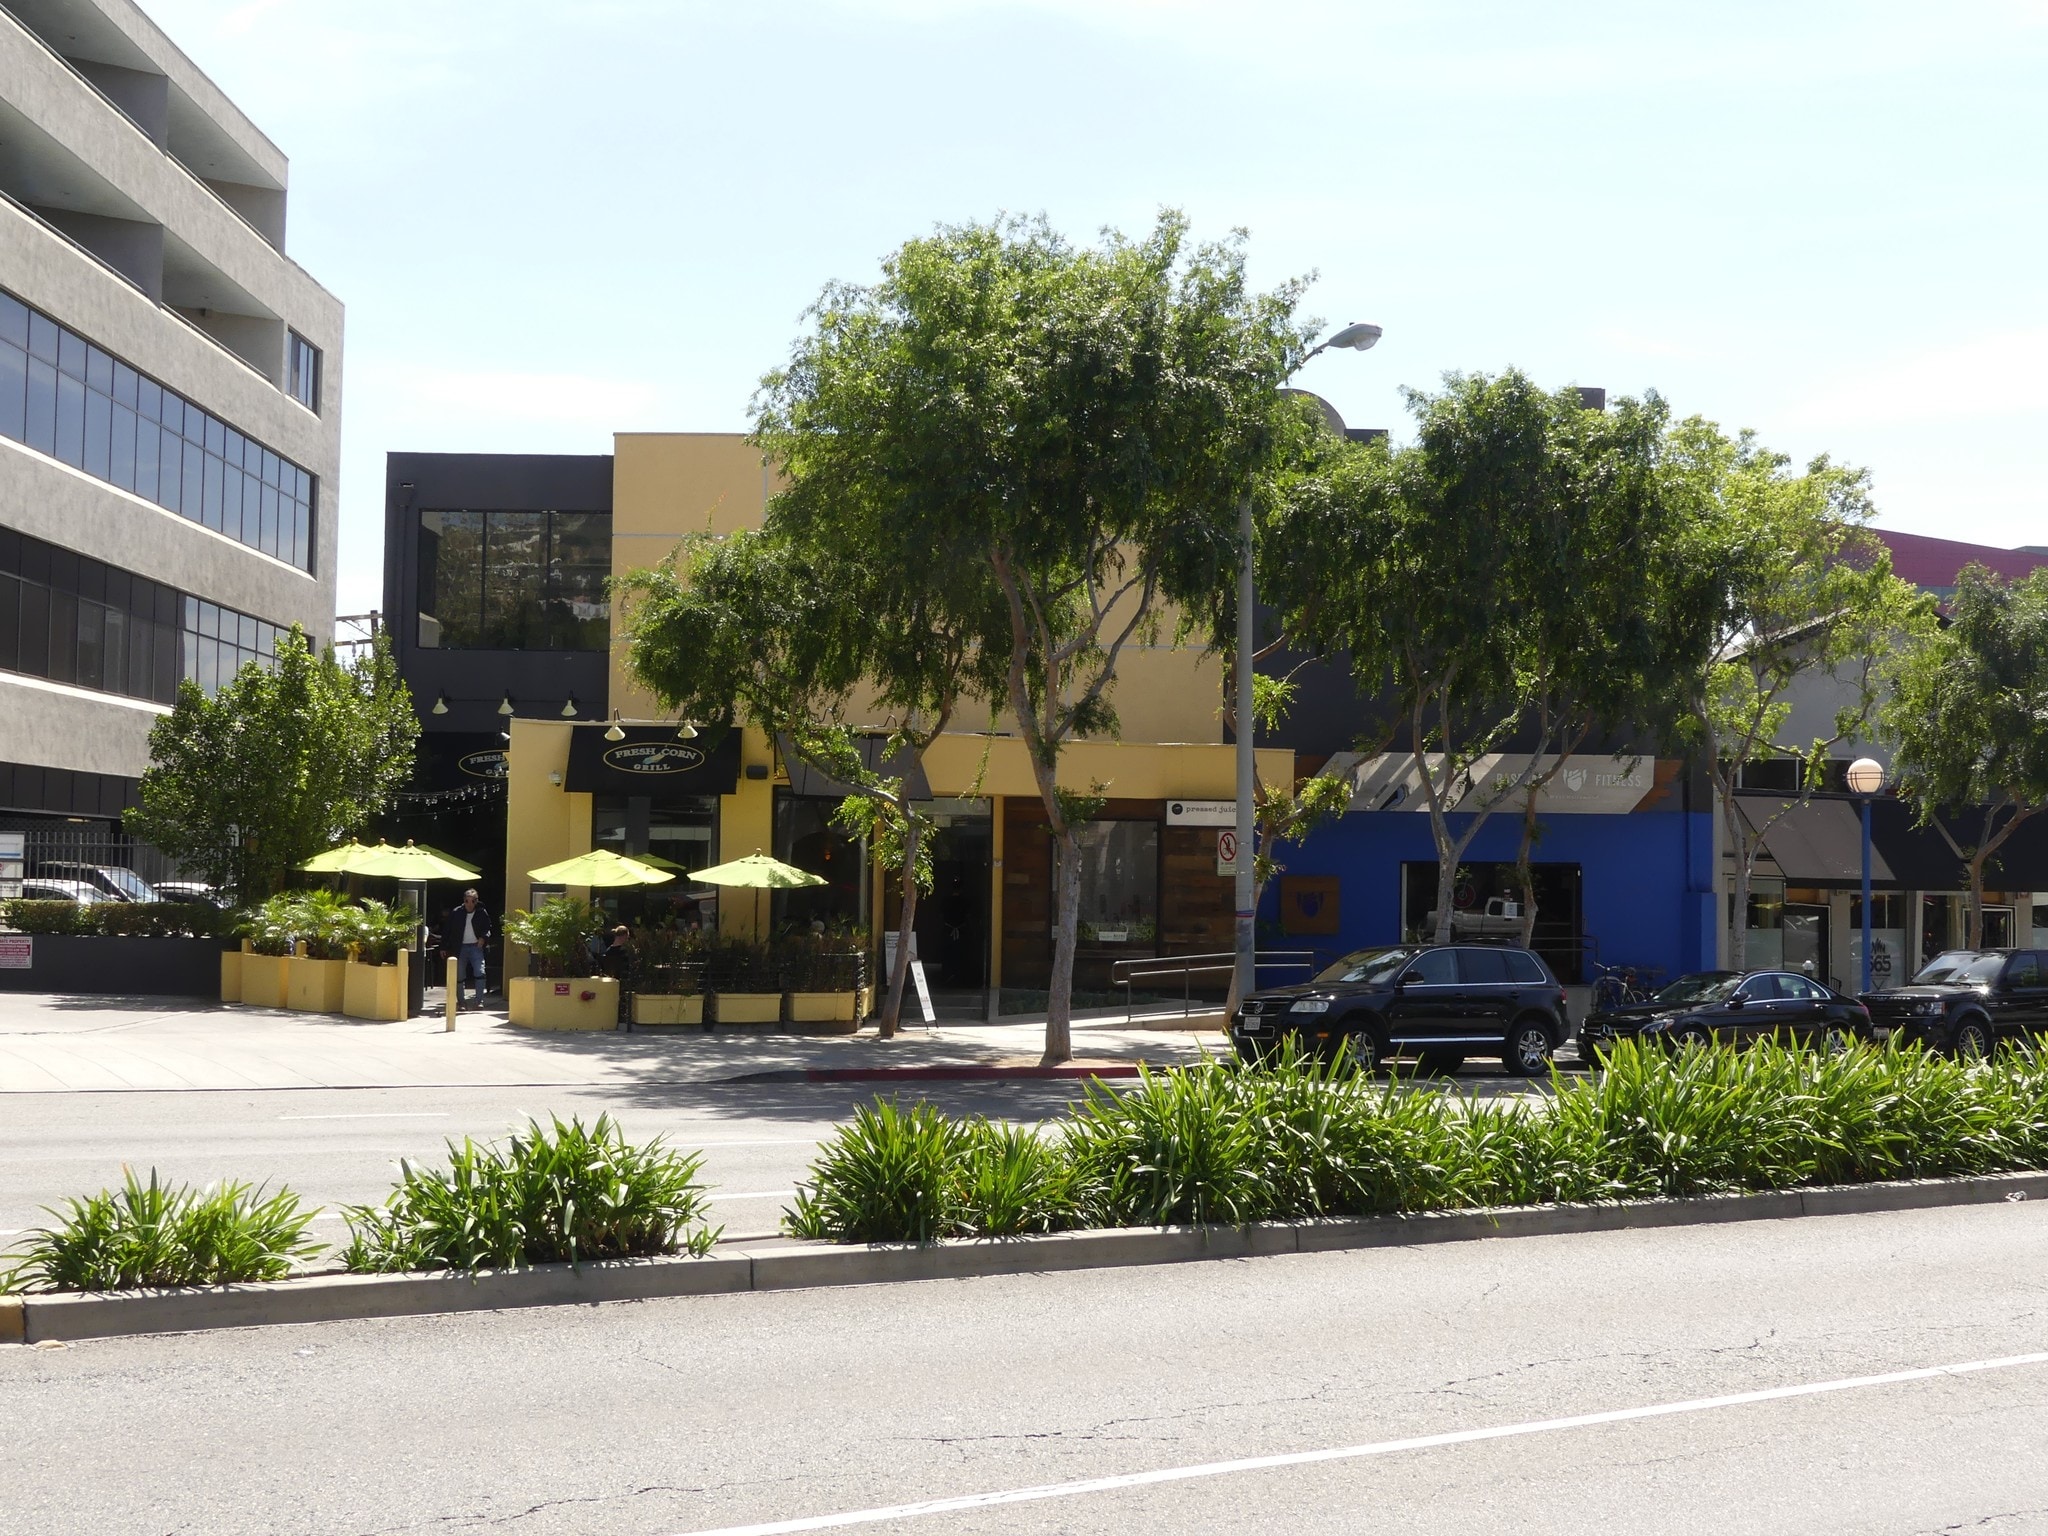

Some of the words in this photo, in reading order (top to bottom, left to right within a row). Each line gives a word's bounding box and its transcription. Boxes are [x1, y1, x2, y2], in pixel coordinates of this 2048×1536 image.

[469, 754, 506, 764] FRESH
[615, 747, 656, 758] FRESH
[661, 748, 697, 760] CORN
[633, 763, 671, 771] GRILL
[1595, 774, 1642, 788] FITNESS
